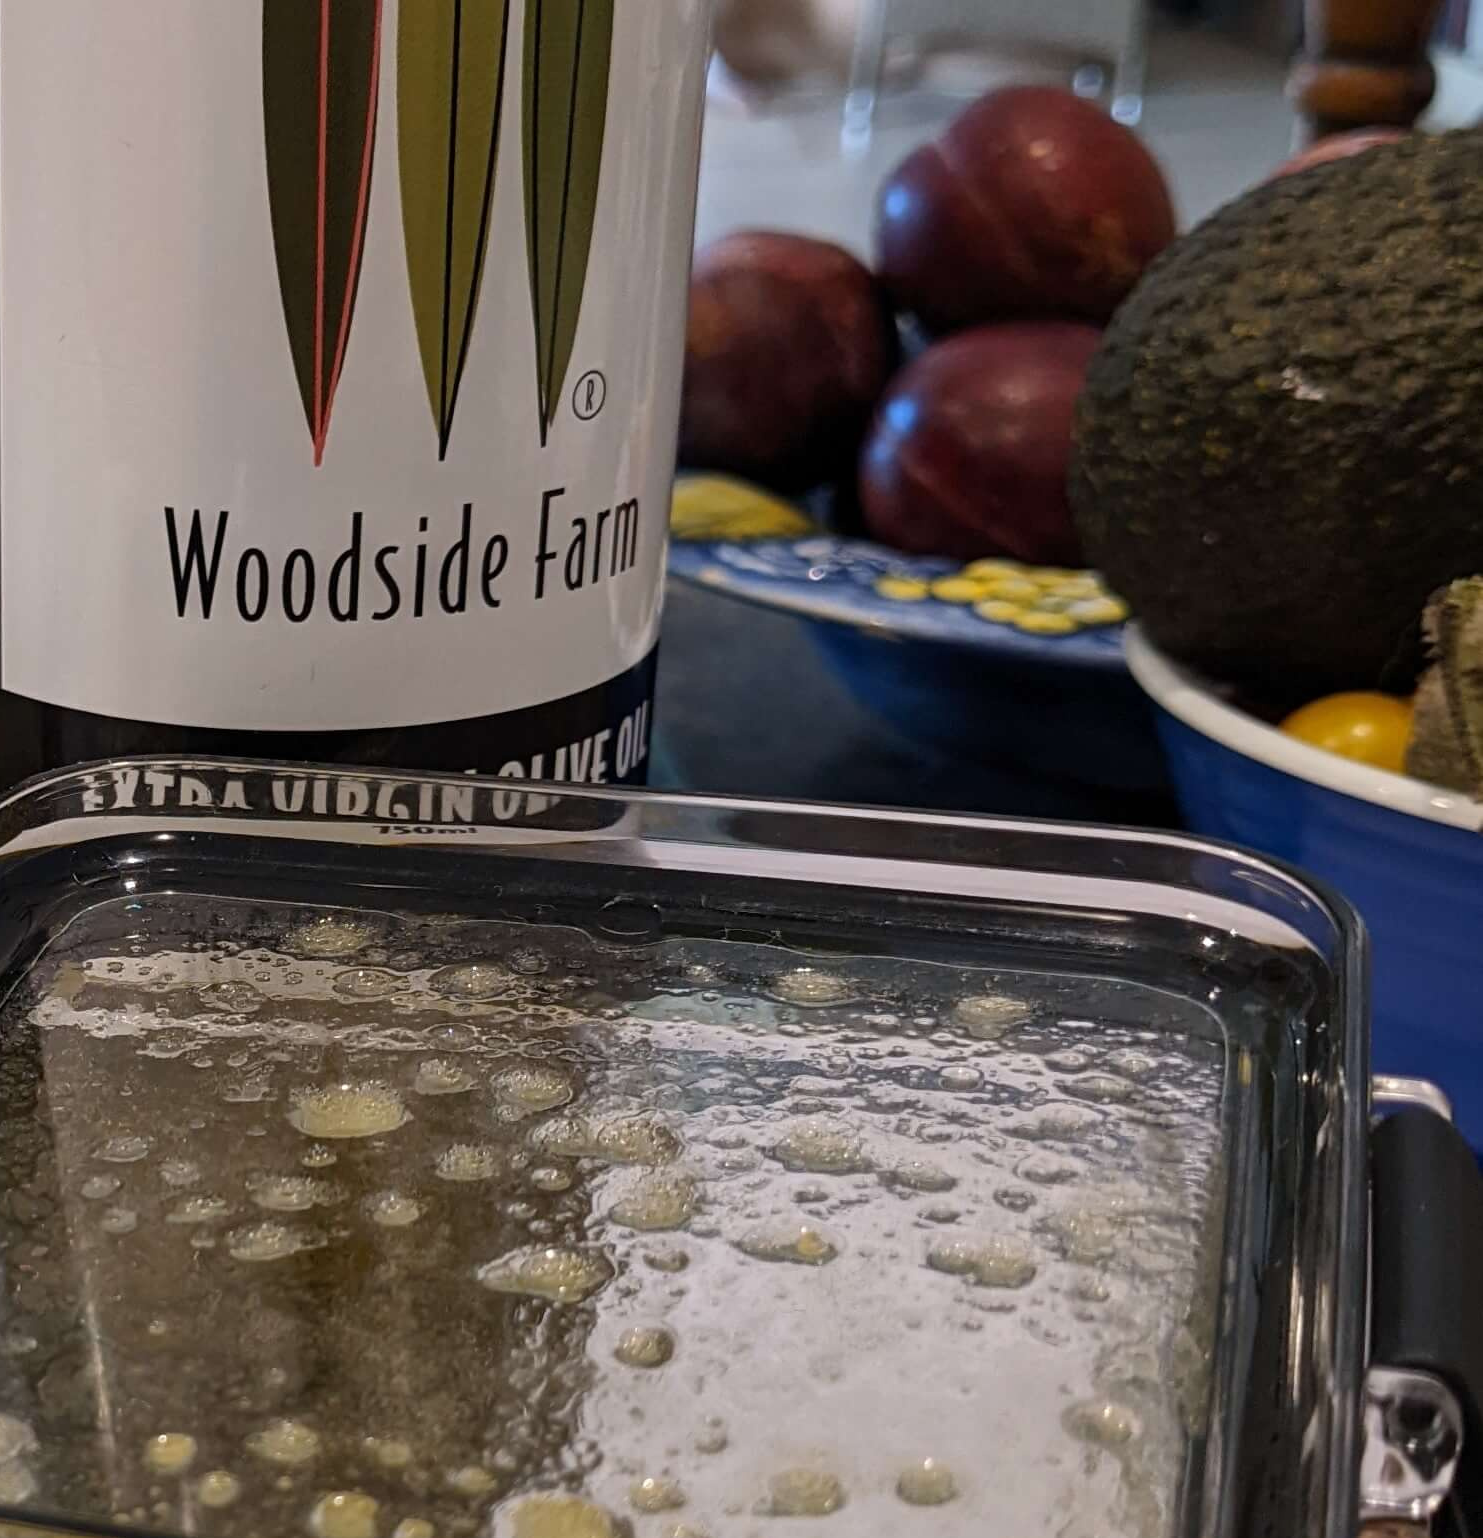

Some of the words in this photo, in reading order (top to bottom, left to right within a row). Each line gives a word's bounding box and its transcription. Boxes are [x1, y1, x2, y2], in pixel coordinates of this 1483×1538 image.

[163, 503, 510, 623] Woodside
[534, 487, 640, 600] Farm
[492, 727, 612, 821] OLIVE
[615, 700, 648, 779] OIL
